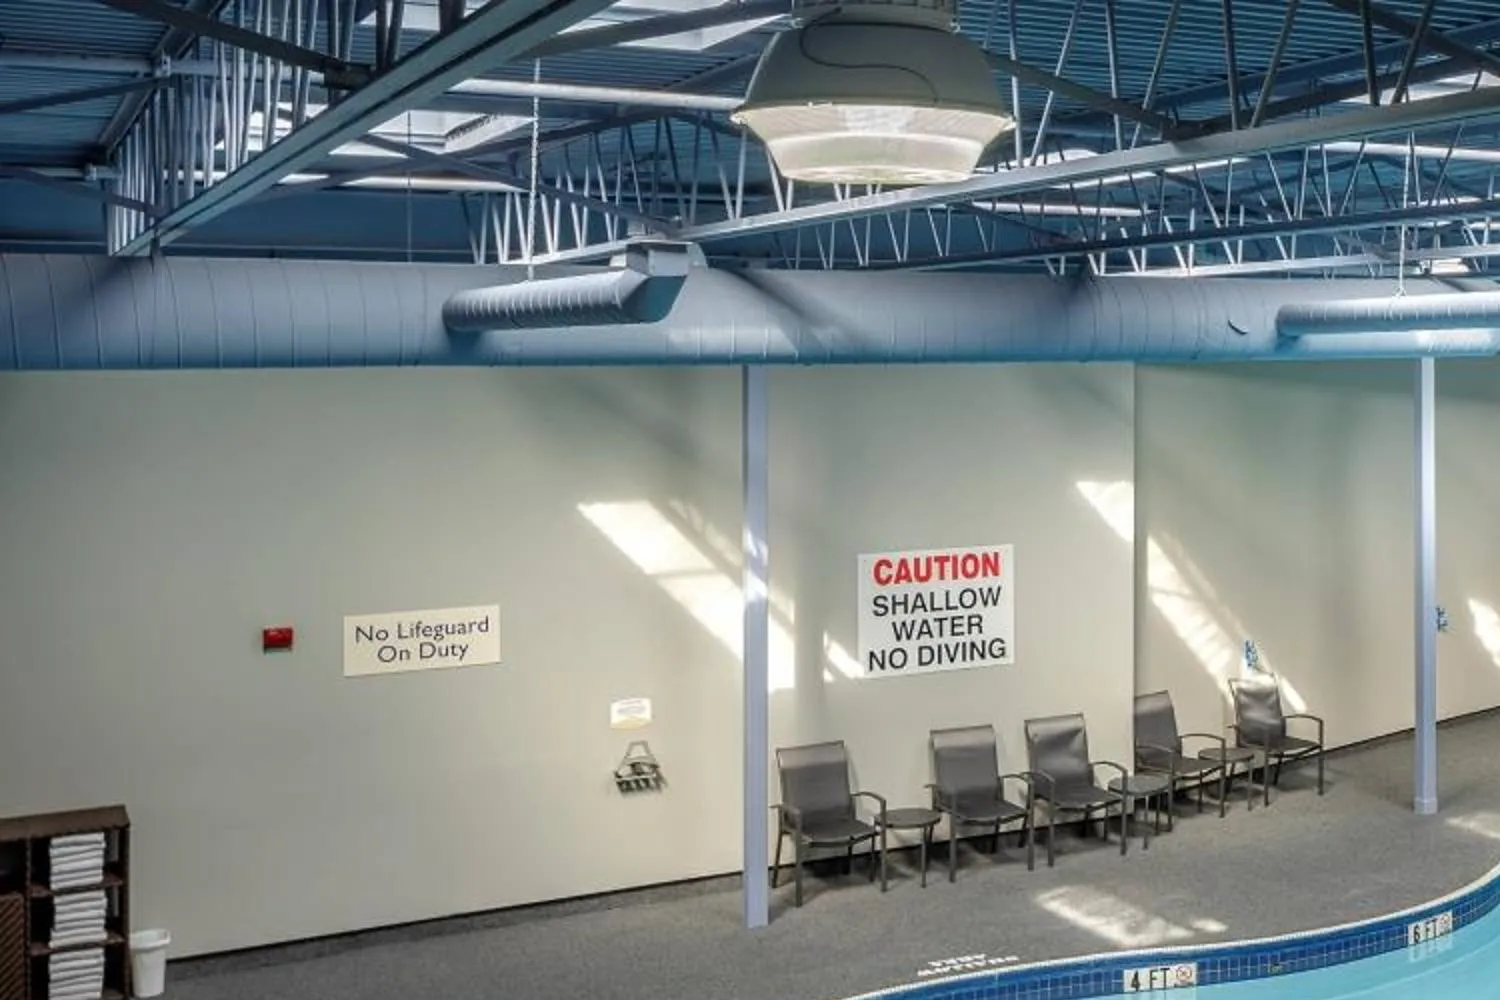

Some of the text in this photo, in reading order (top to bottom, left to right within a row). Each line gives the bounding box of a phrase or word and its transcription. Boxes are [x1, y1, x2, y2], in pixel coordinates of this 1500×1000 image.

[873, 551, 1000, 586] CAUTION
[873, 586, 1002, 617] SHALLOW
[355, 615, 489, 644] No Lifeguard
[892, 613, 983, 642] WATER
[377, 641, 469, 663] On Duty
[868, 638, 1006, 671] NO DIVING
[1413, 917, 1438, 944] 6 FT
[1130, 967, 1170, 992] 4 FT
